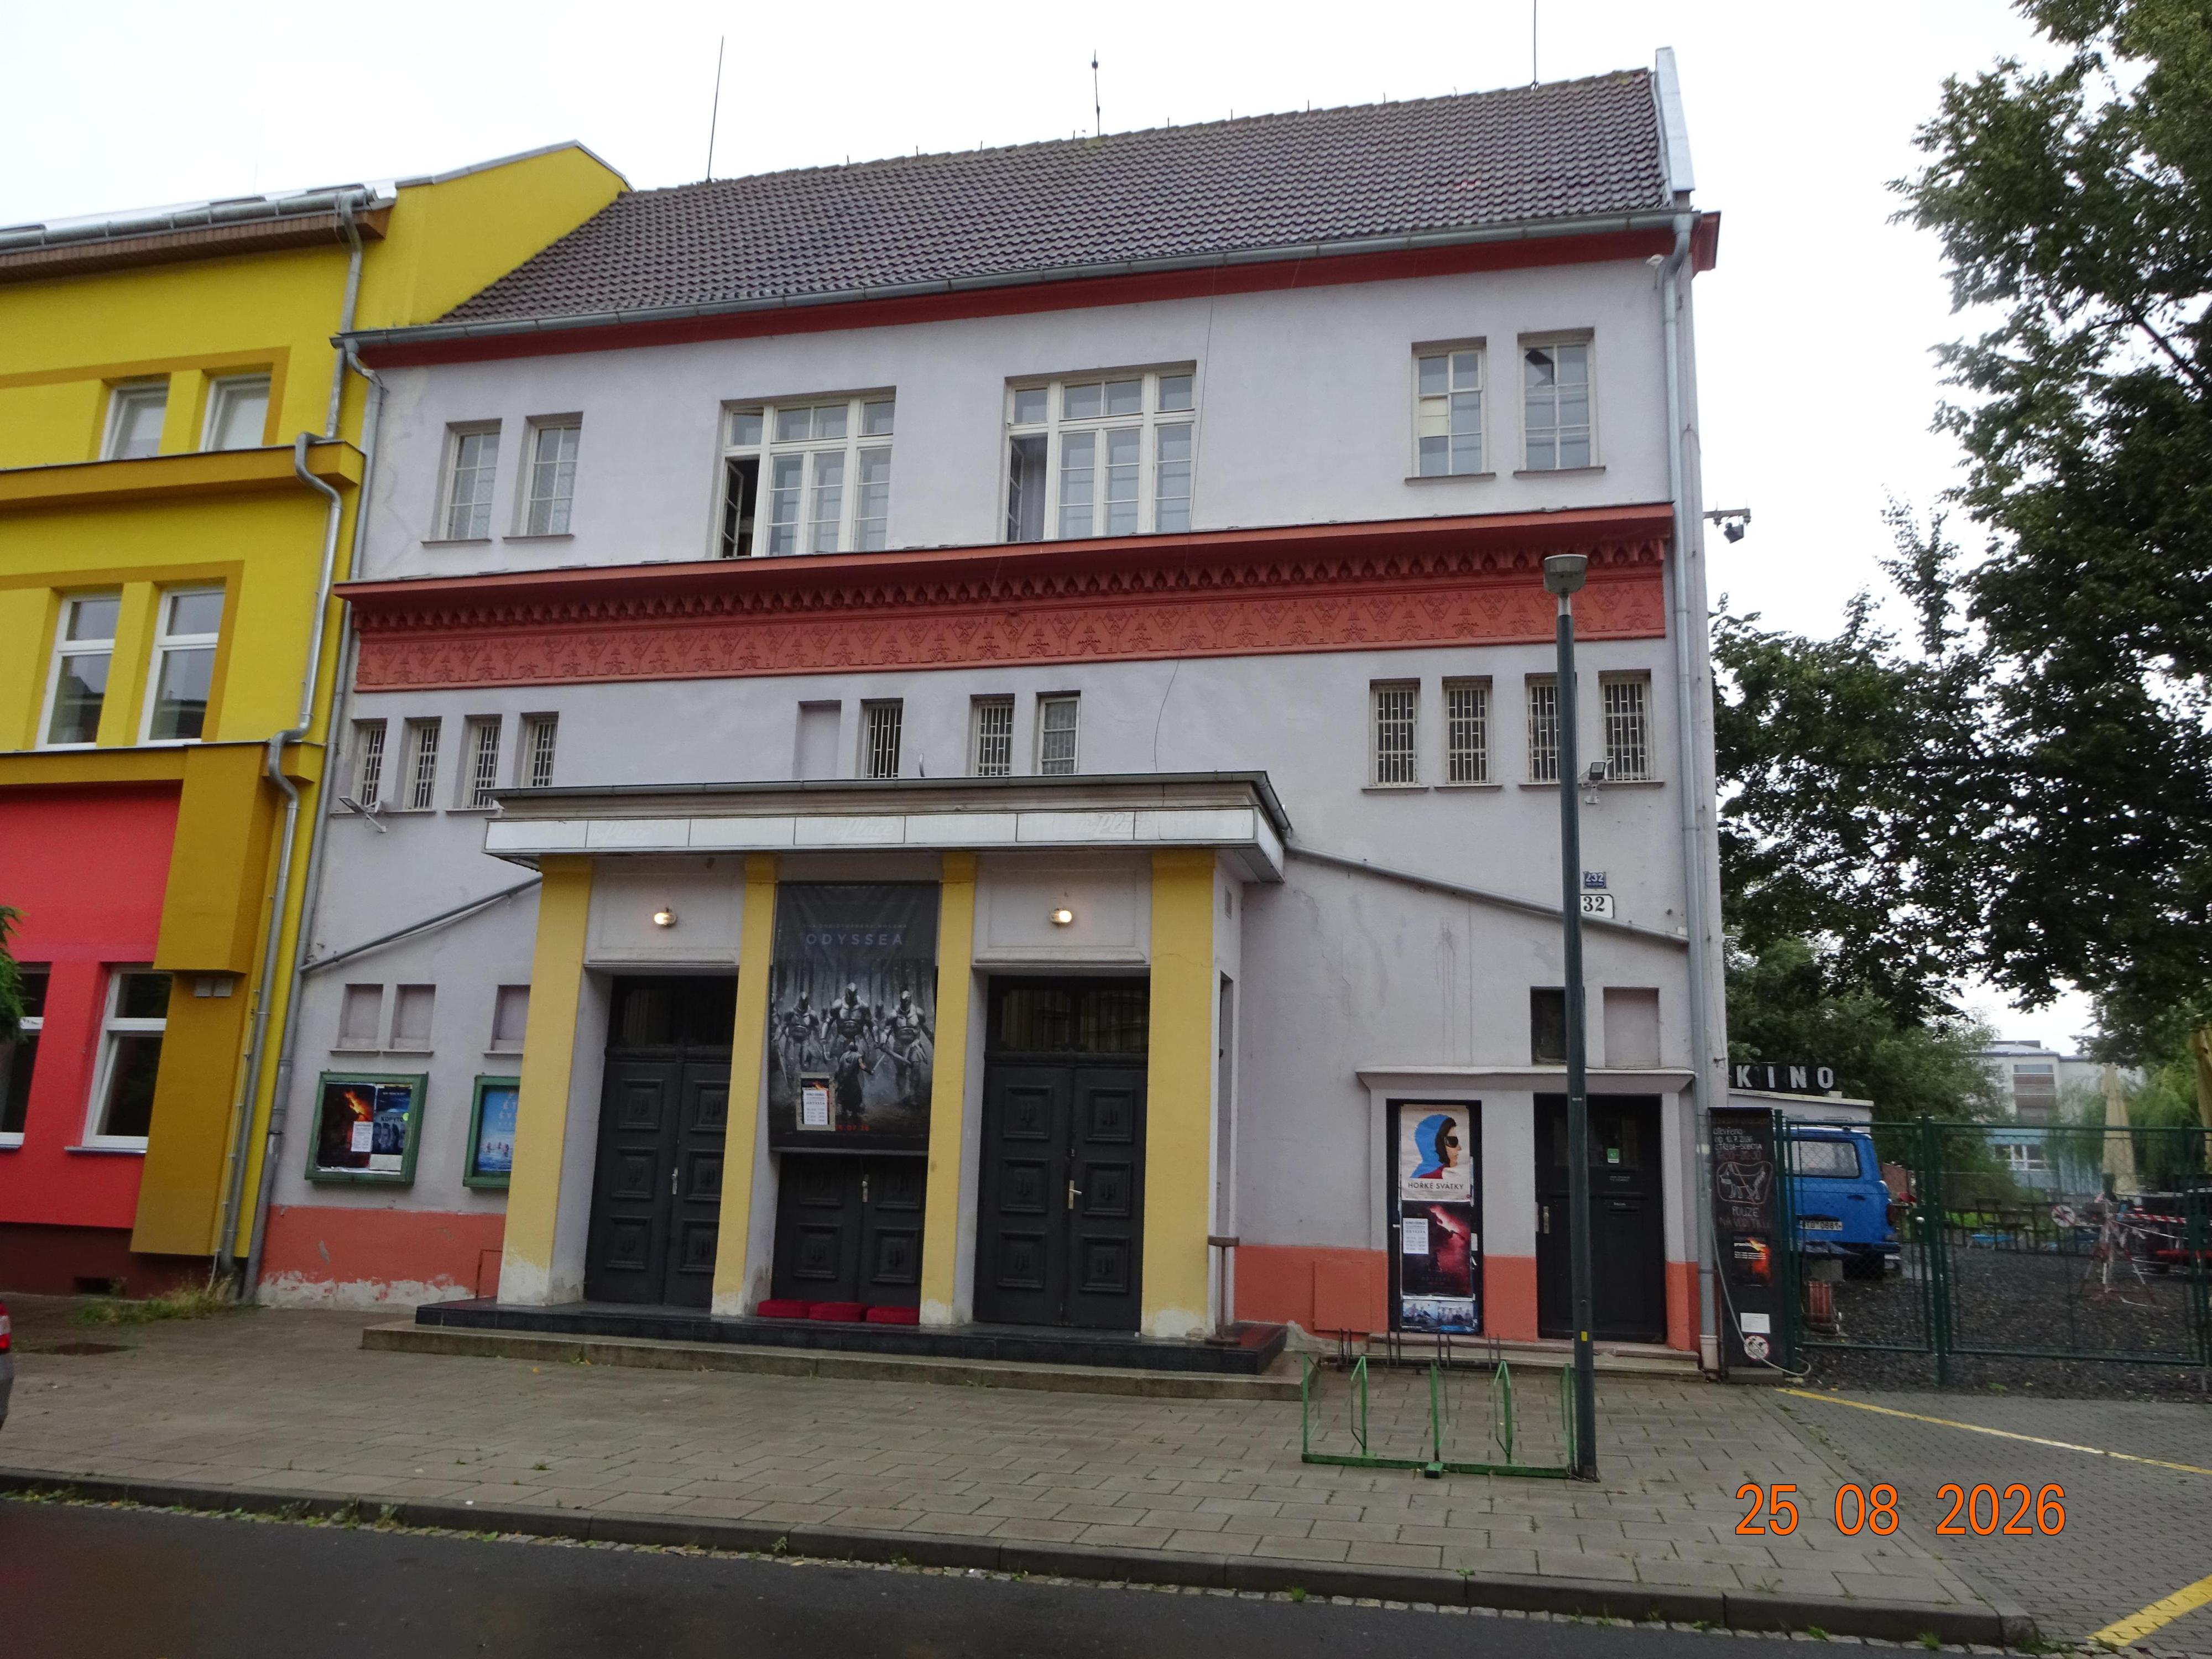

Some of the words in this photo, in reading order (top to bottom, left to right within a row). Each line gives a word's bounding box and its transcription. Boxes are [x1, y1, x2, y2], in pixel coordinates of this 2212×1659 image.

[1585, 873, 1604, 882] 232
[806, 933, 902, 945] ODYSSEA
[1736, 1065, 1834, 1089] KINO
[1408, 1181, 1433, 1189] HOŘKÉ
